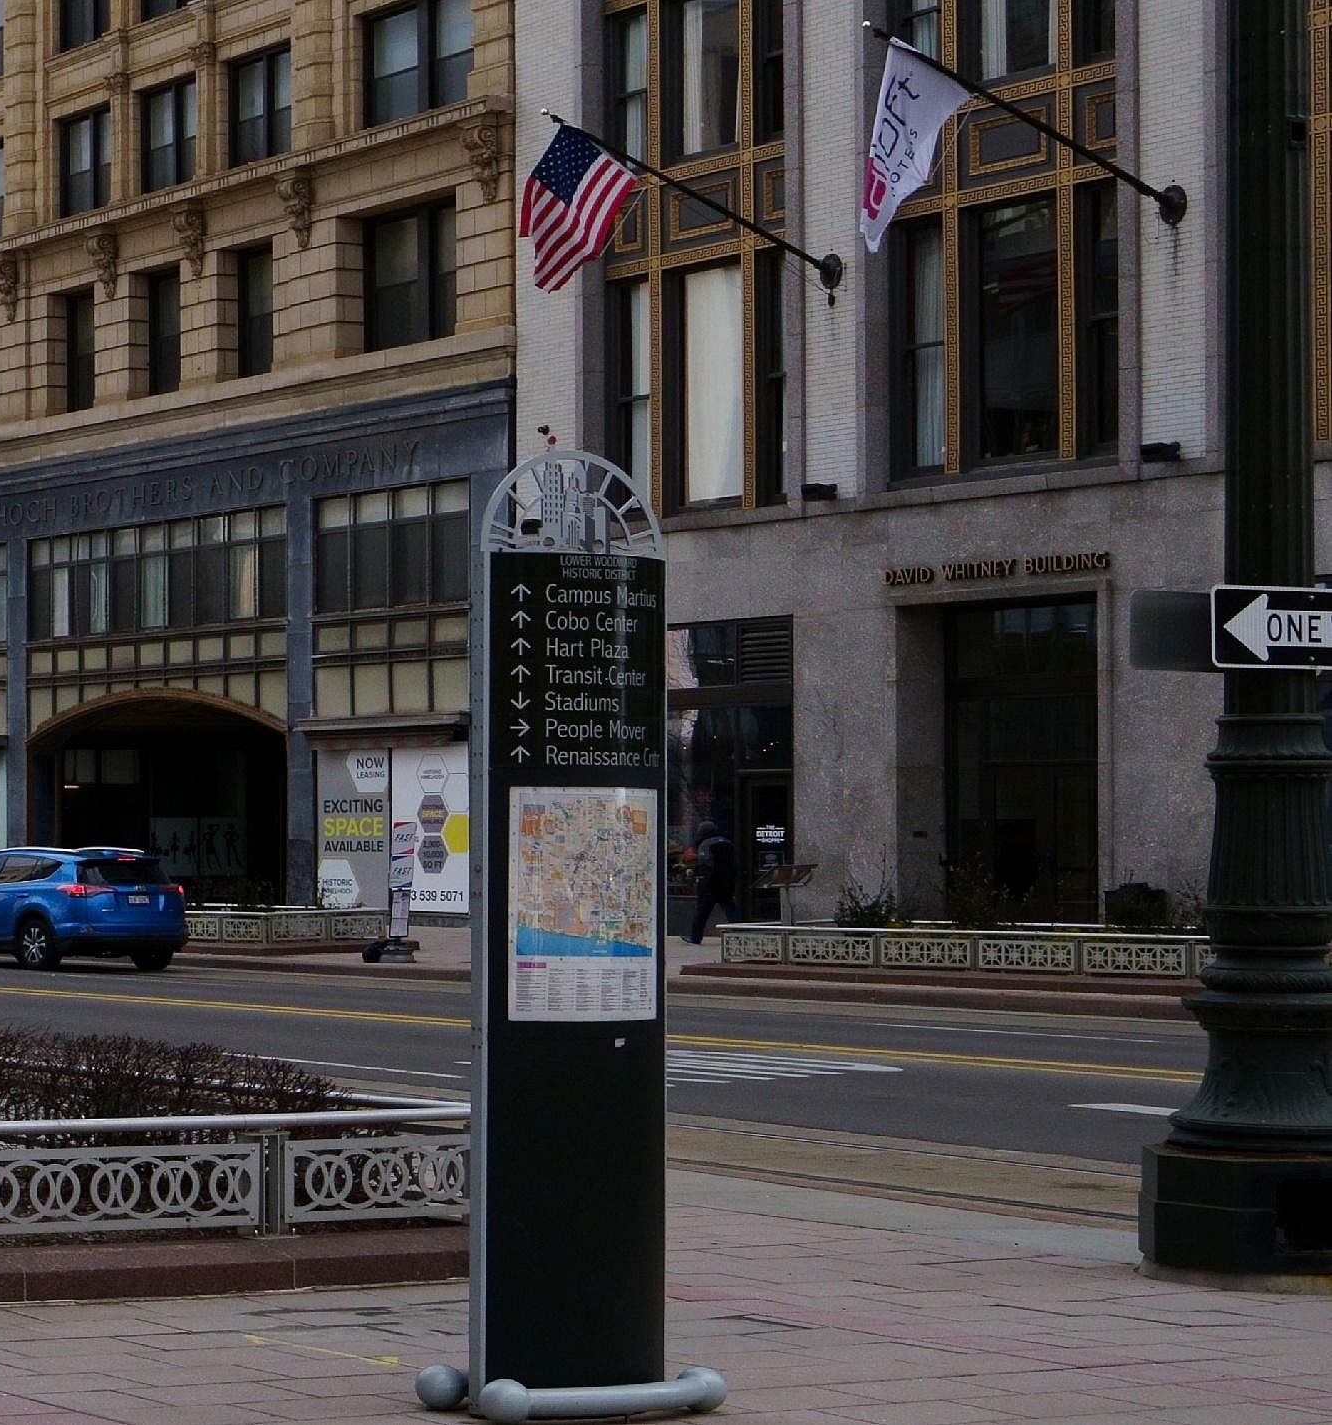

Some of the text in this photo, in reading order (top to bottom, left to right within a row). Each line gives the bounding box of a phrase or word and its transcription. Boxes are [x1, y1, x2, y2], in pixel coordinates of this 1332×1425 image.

[70, 476, 193, 519] BROTHERS
[211, 466, 264, 496] AND
[280, 439, 421, 485] COMPANY
[560, 555, 592, 567] LOWER
[882, 552, 1110, 586] DAVID WHITNEY BUILDING
[562, 567, 603, 579] HISTORIC
[545, 583, 657, 608] Campus Martius
[545, 610, 638, 632] Cobo Center
[1267, 613, 1323, 643] ONE
[546, 637, 629, 659] Hart Plaza
[544, 664, 646, 686] Transit Center
[544, 691, 620, 712] Stadiums
[545, 718, 646, 743] People Mover
[356, 757, 385, 769] NOW
[545, 745, 641, 766] Renaissance
[356, 771, 385, 779] LEASING
[323, 799, 383, 814] EXCITING
[323, 816, 384, 837] SPACE
[756, 830, 785, 838] DETROIT
[324, 840, 384, 852] AVAILABLE
[419, 890, 437, 902] 539
[440, 890, 464, 902] 5071
